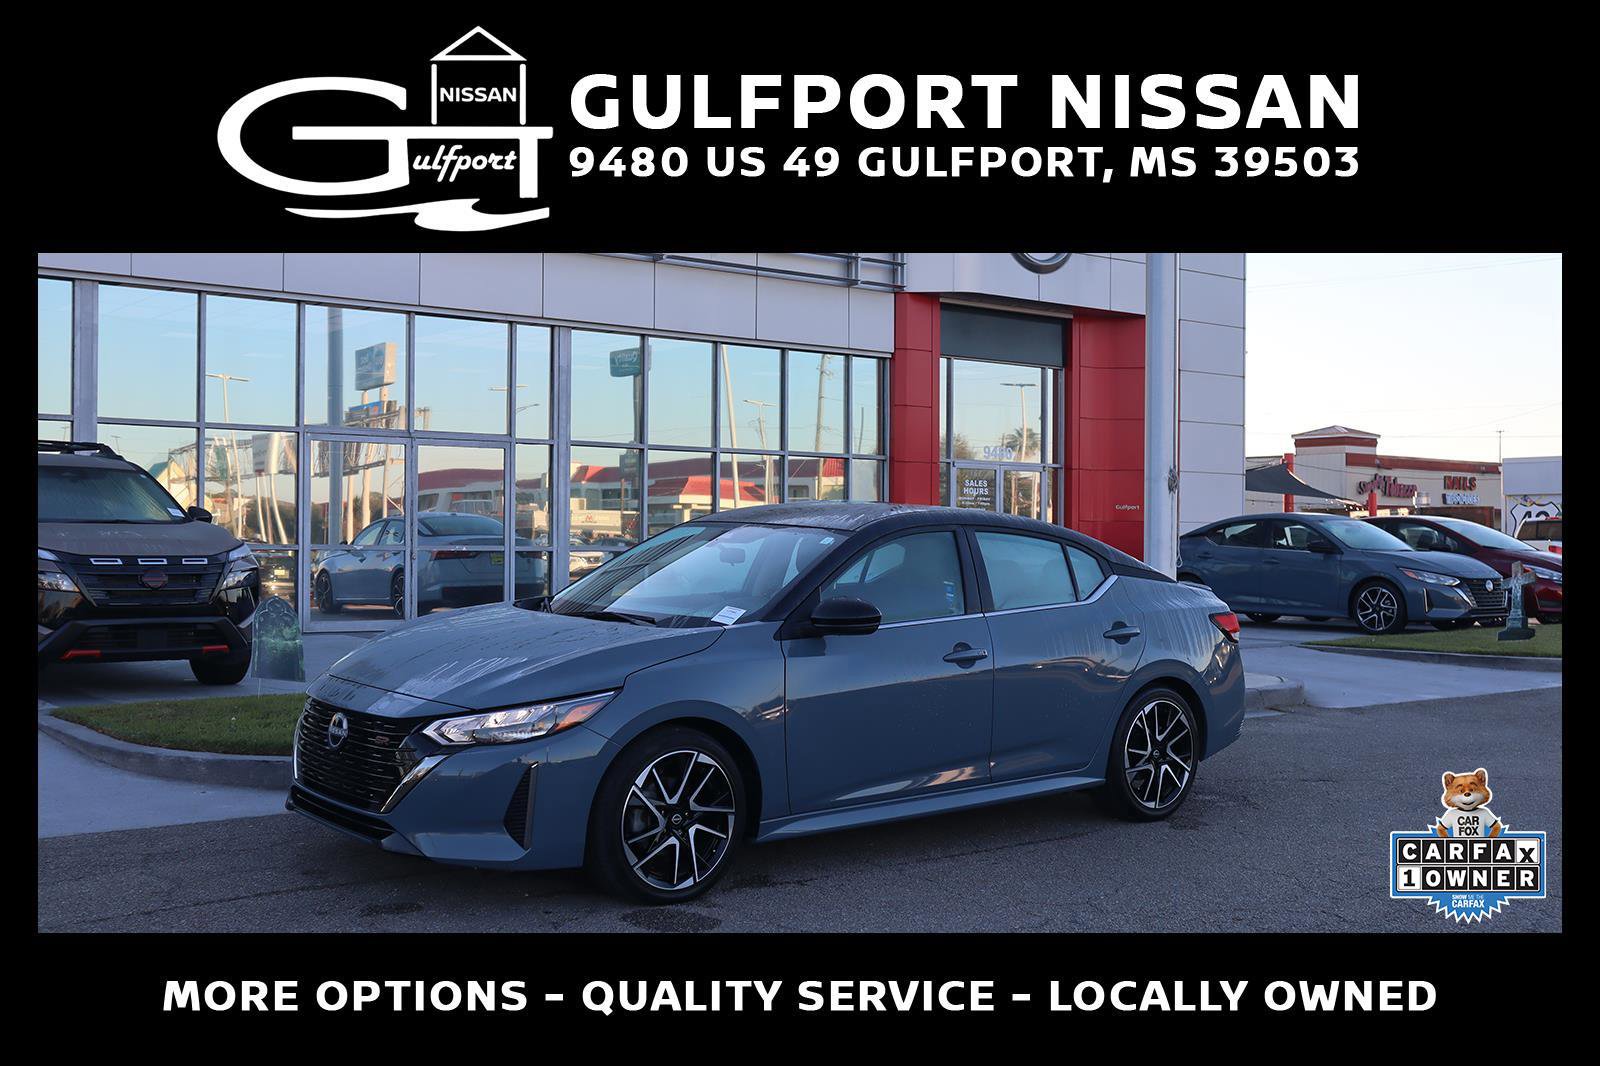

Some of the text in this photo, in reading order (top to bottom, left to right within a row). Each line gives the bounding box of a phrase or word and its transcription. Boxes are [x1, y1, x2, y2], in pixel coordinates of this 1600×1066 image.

[984, 446, 1012, 460] 9480
[964, 479, 988, 488] SALES
[1444, 475, 1477, 491] NAILS
[963, 487, 989, 496] HOURS
